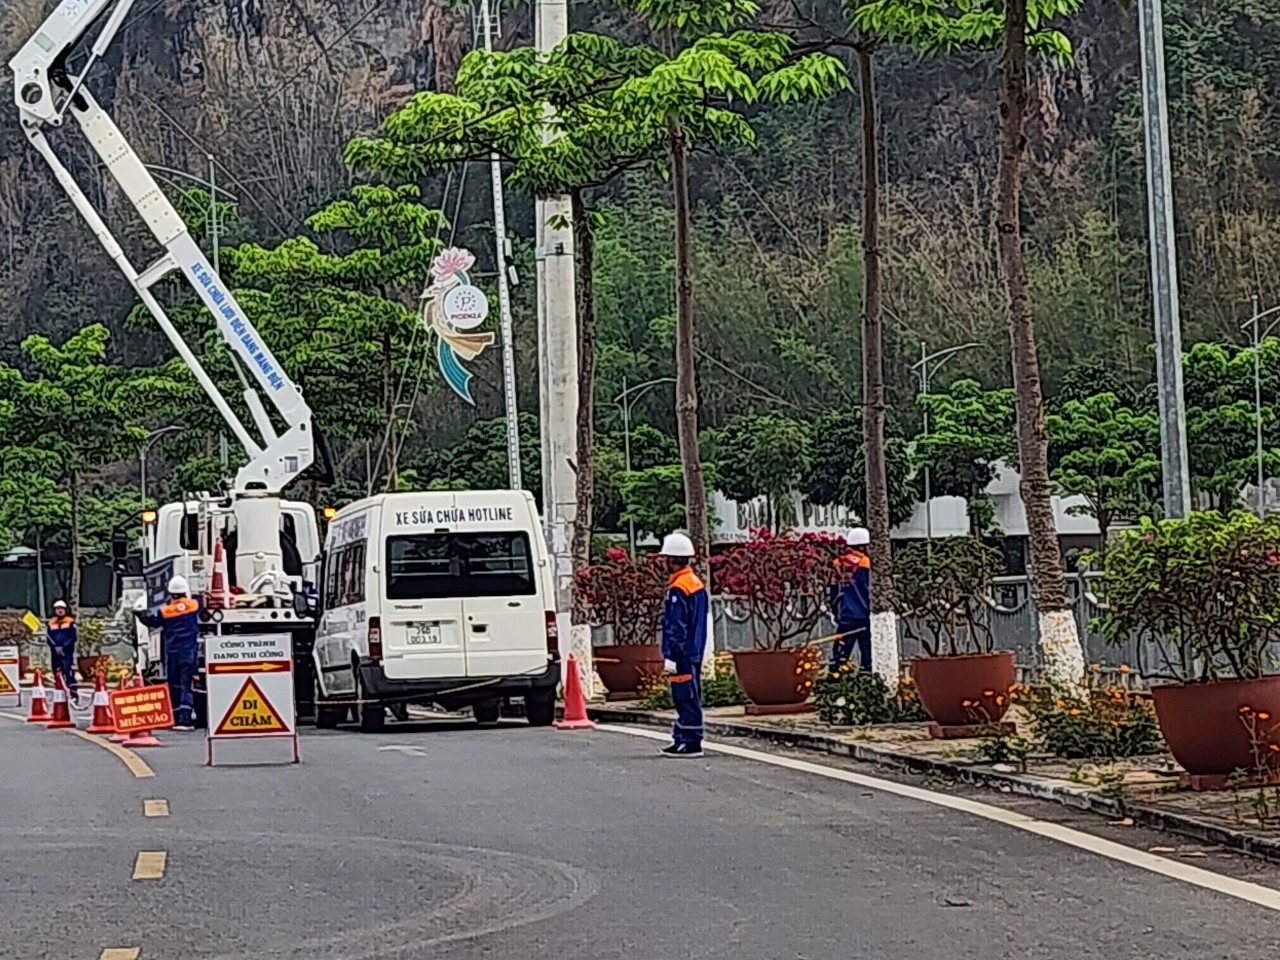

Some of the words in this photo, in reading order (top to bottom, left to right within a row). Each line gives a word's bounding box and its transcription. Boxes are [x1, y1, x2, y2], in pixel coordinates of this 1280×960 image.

[395, 511, 409, 526] XE
[412, 505, 434, 525] SỬA
[436, 504, 466, 523] CHỮA
[468, 507, 513, 522] HOTLINE
[146, 711, 169, 724] VÀO
